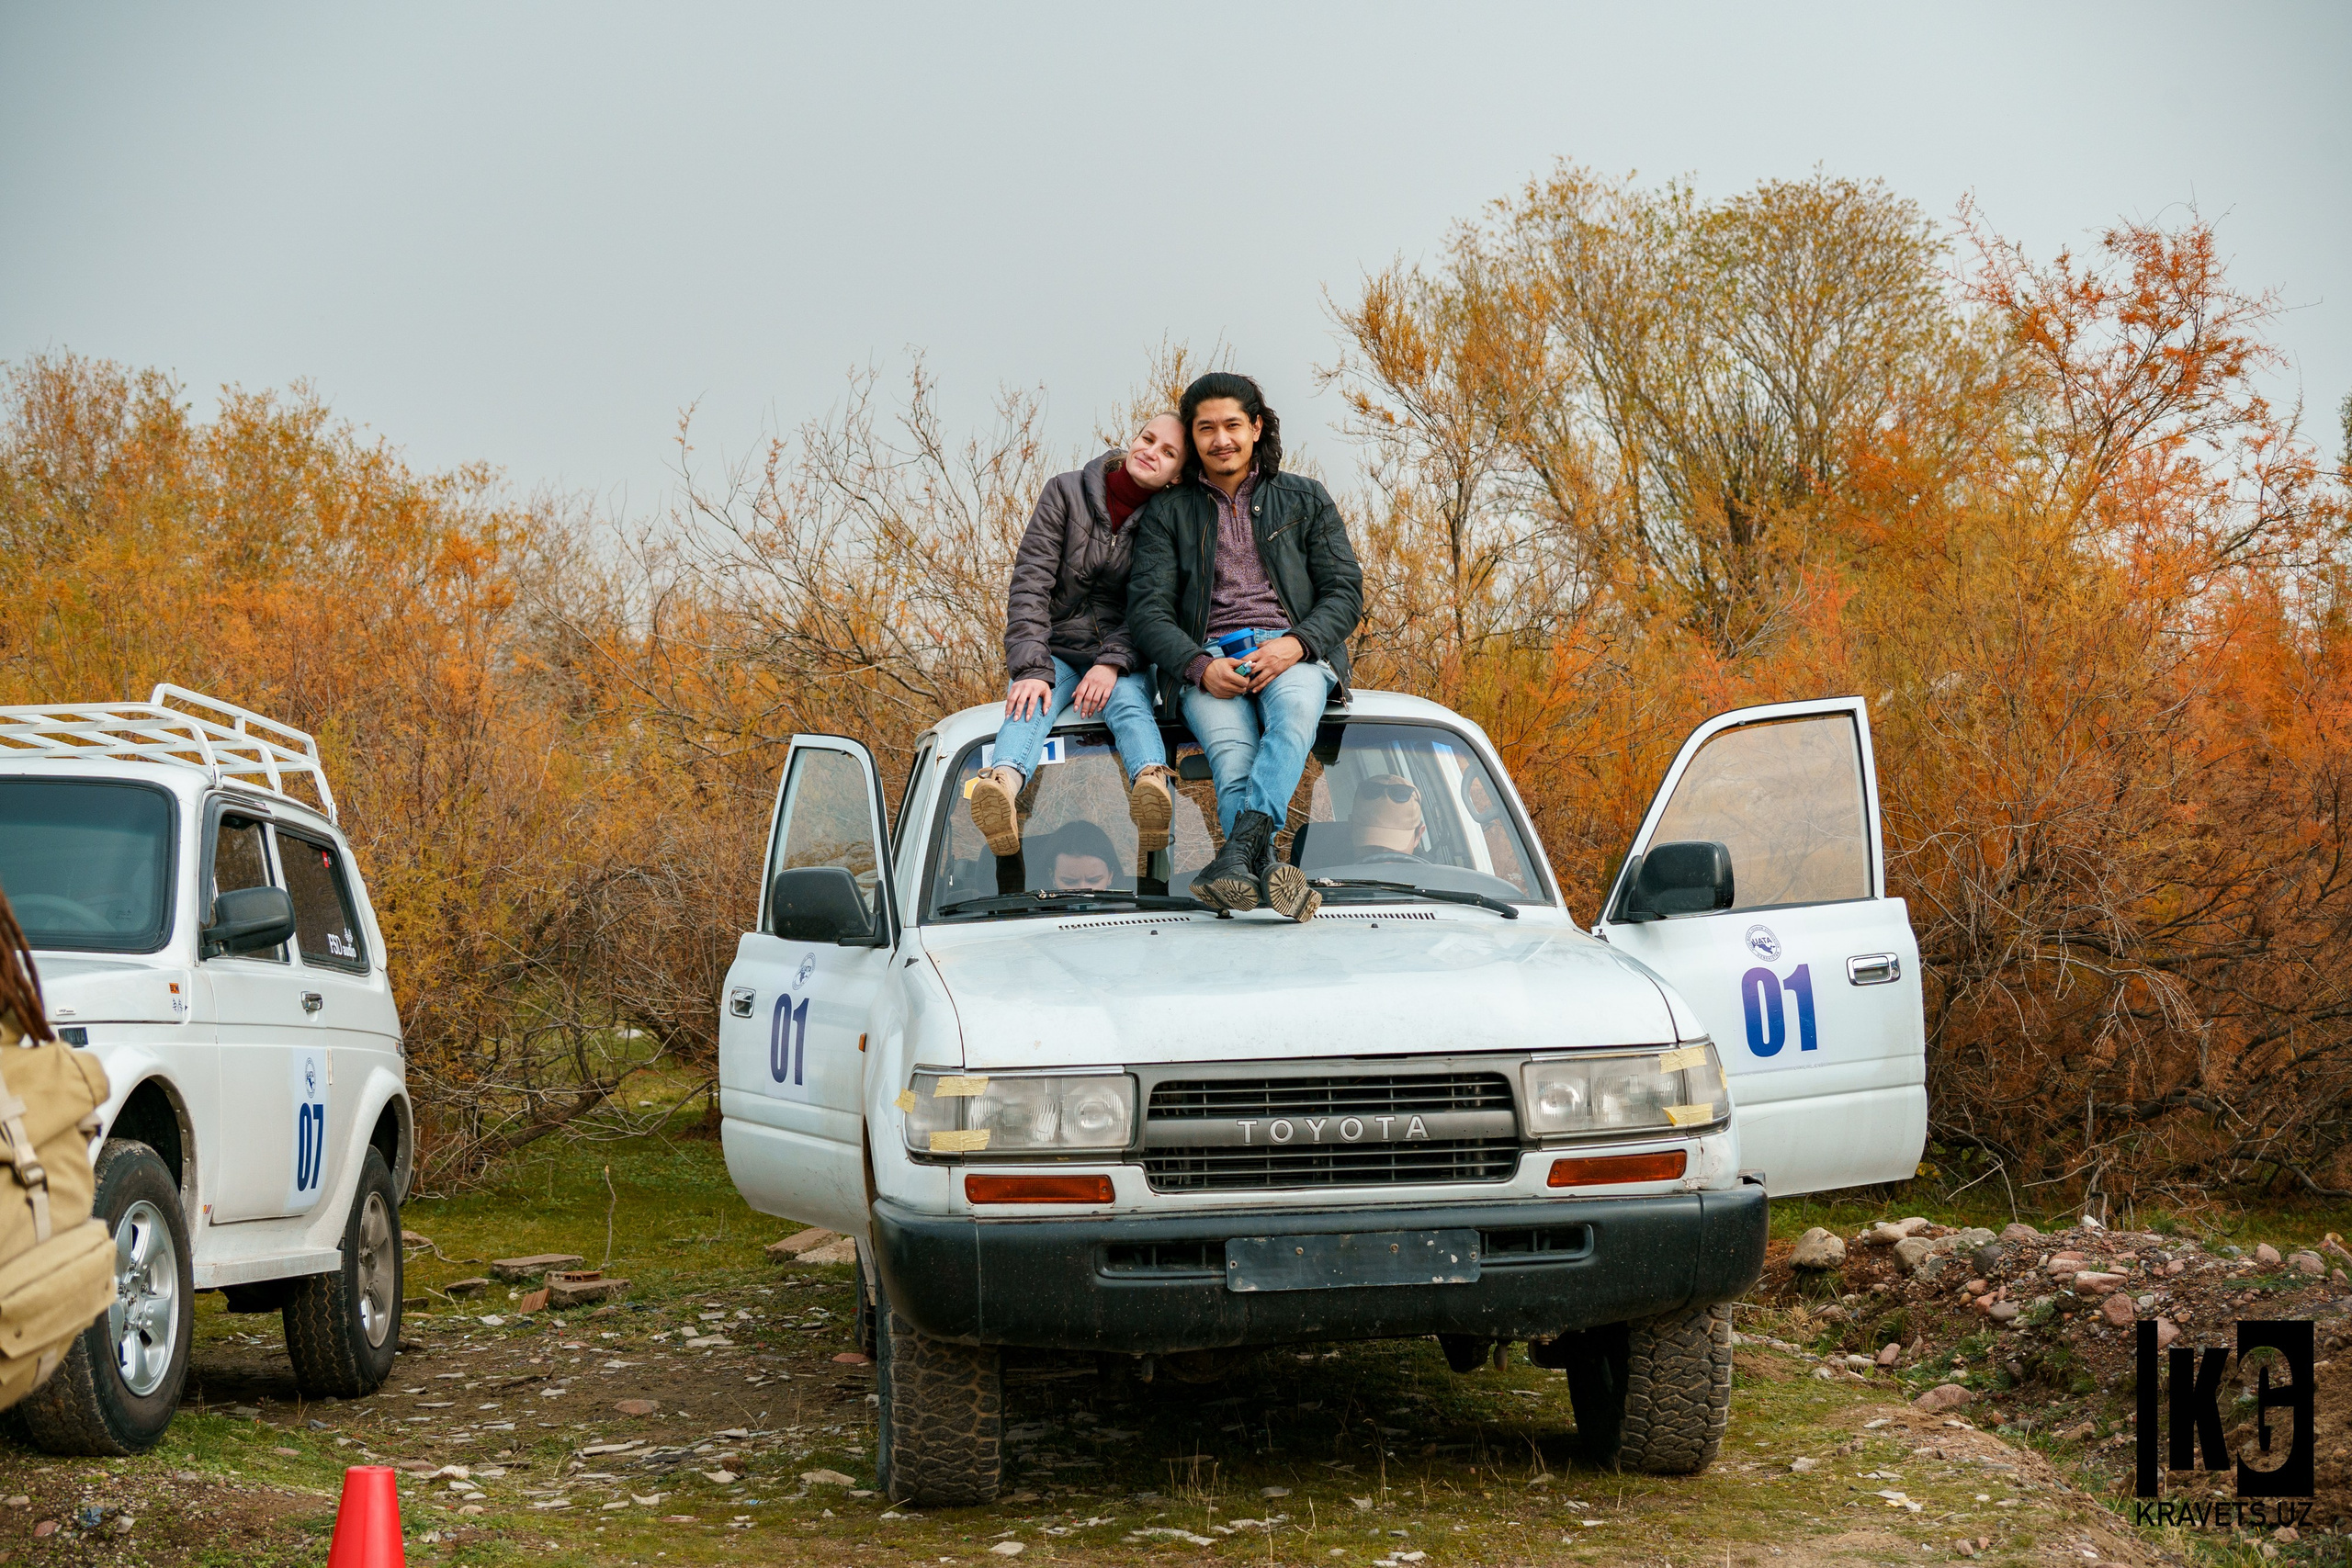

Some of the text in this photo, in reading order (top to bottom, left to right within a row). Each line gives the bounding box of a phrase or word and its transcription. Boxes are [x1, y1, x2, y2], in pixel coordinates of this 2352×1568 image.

[1044, 740, 1057, 761] 1
[1751, 937, 1773, 945] UATA
[770, 993, 810, 1086] 01
[1741, 964, 1818, 1058] 01
[297, 1102, 324, 1192] 07
[1237, 1115, 1430, 1144] TOYOTA
